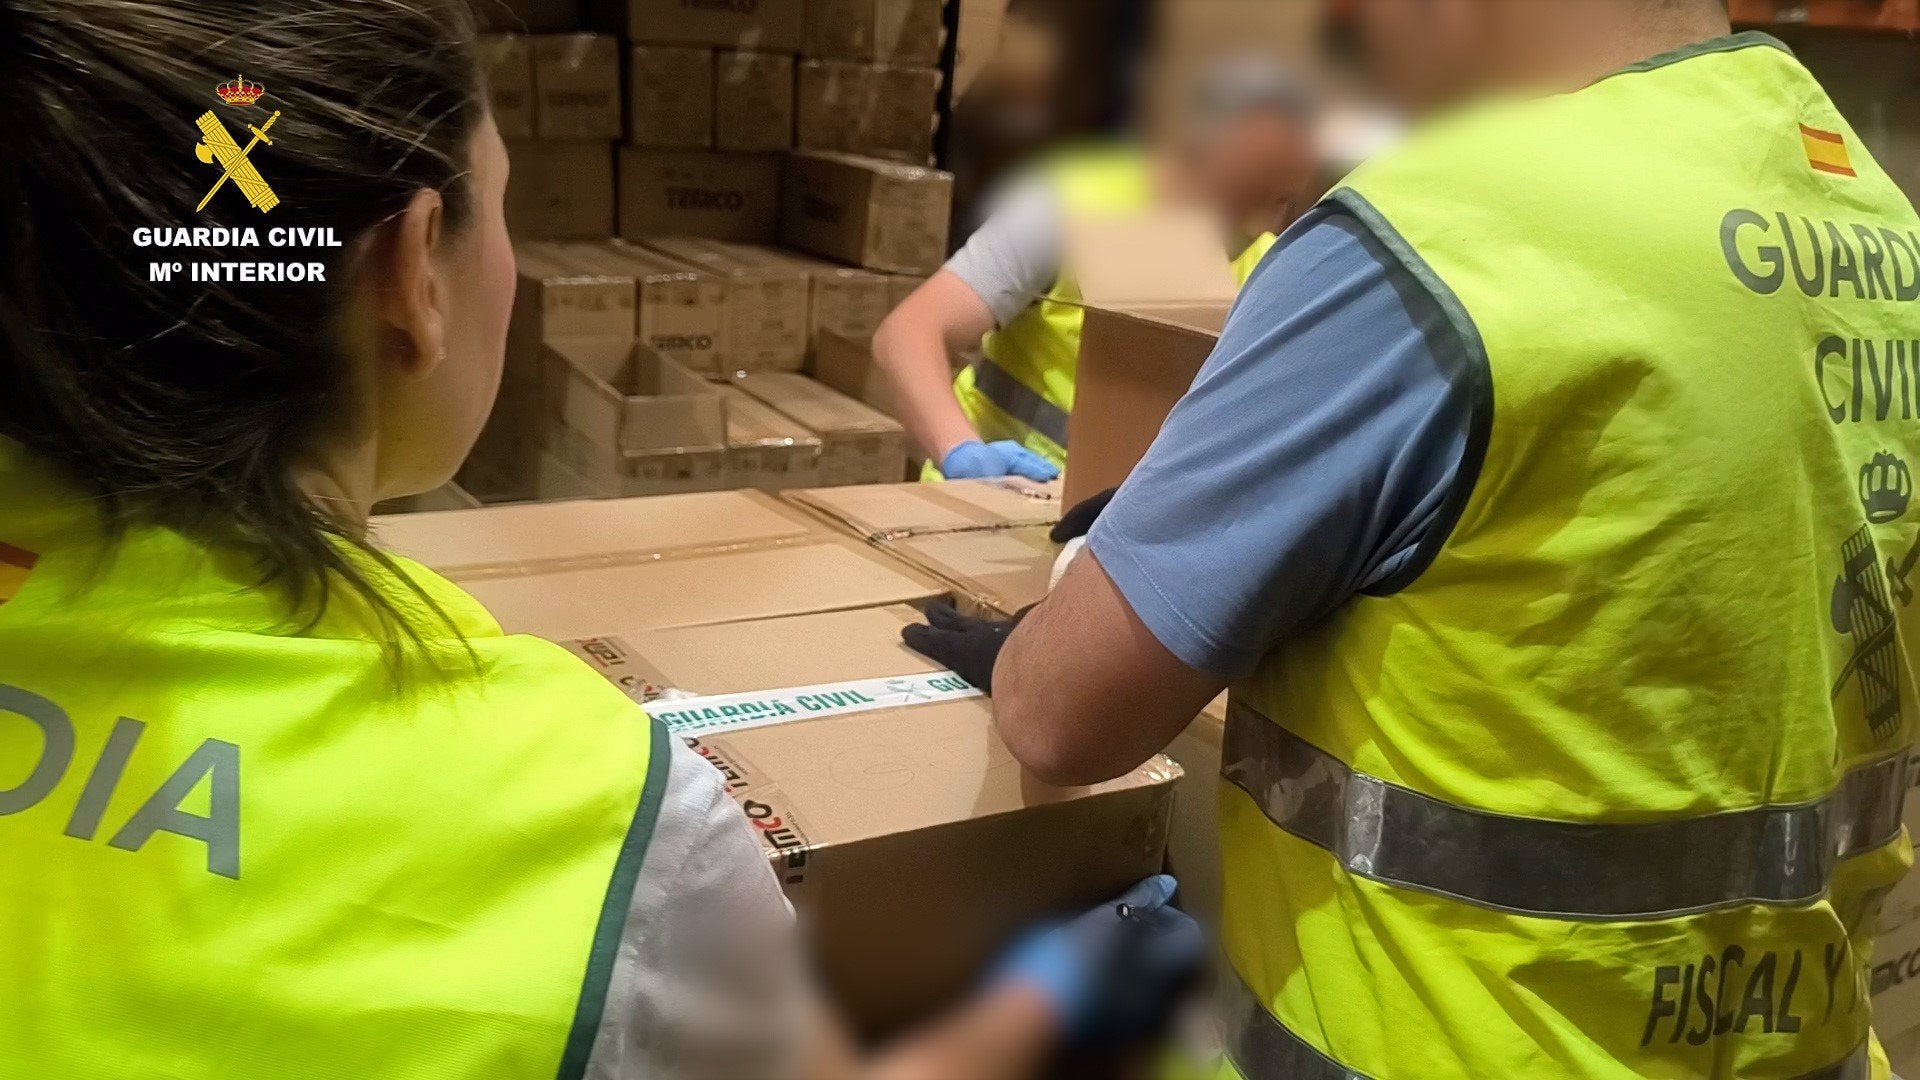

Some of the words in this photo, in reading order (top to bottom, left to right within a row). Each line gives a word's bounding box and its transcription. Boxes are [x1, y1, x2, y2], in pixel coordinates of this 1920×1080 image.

[659, 699, 796, 730] GUARDIA
[799, 689, 875, 712] CIVIL
[1641, 944, 1803, 1047] FISCAL
[1823, 942, 1848, 1026] Y
